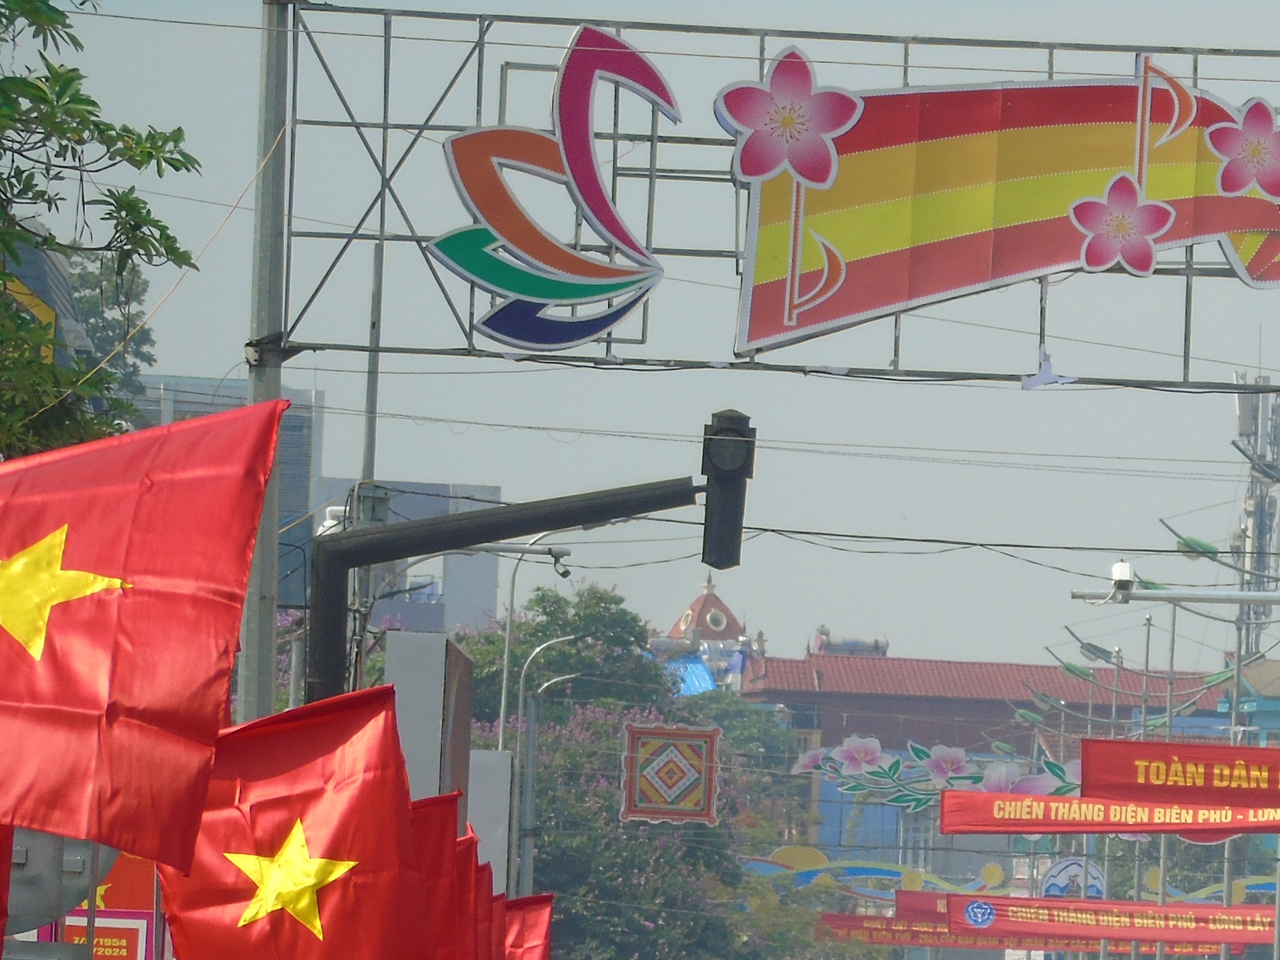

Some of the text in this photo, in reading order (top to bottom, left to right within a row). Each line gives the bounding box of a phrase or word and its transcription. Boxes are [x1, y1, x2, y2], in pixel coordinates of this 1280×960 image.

[1135, 756, 1205, 787] TOÀN
[1213, 761, 1269, 790] DÂN
[993, 798, 1045, 820] CHIẾN
[1050, 800, 1104, 823] THẮNG
[1110, 804, 1149, 825] ĐIỆN
[1154, 806, 1193, 824] BIÊN
[1198, 806, 1232, 824] PHỦ
[73, 936, 127, 947] 7//1954
